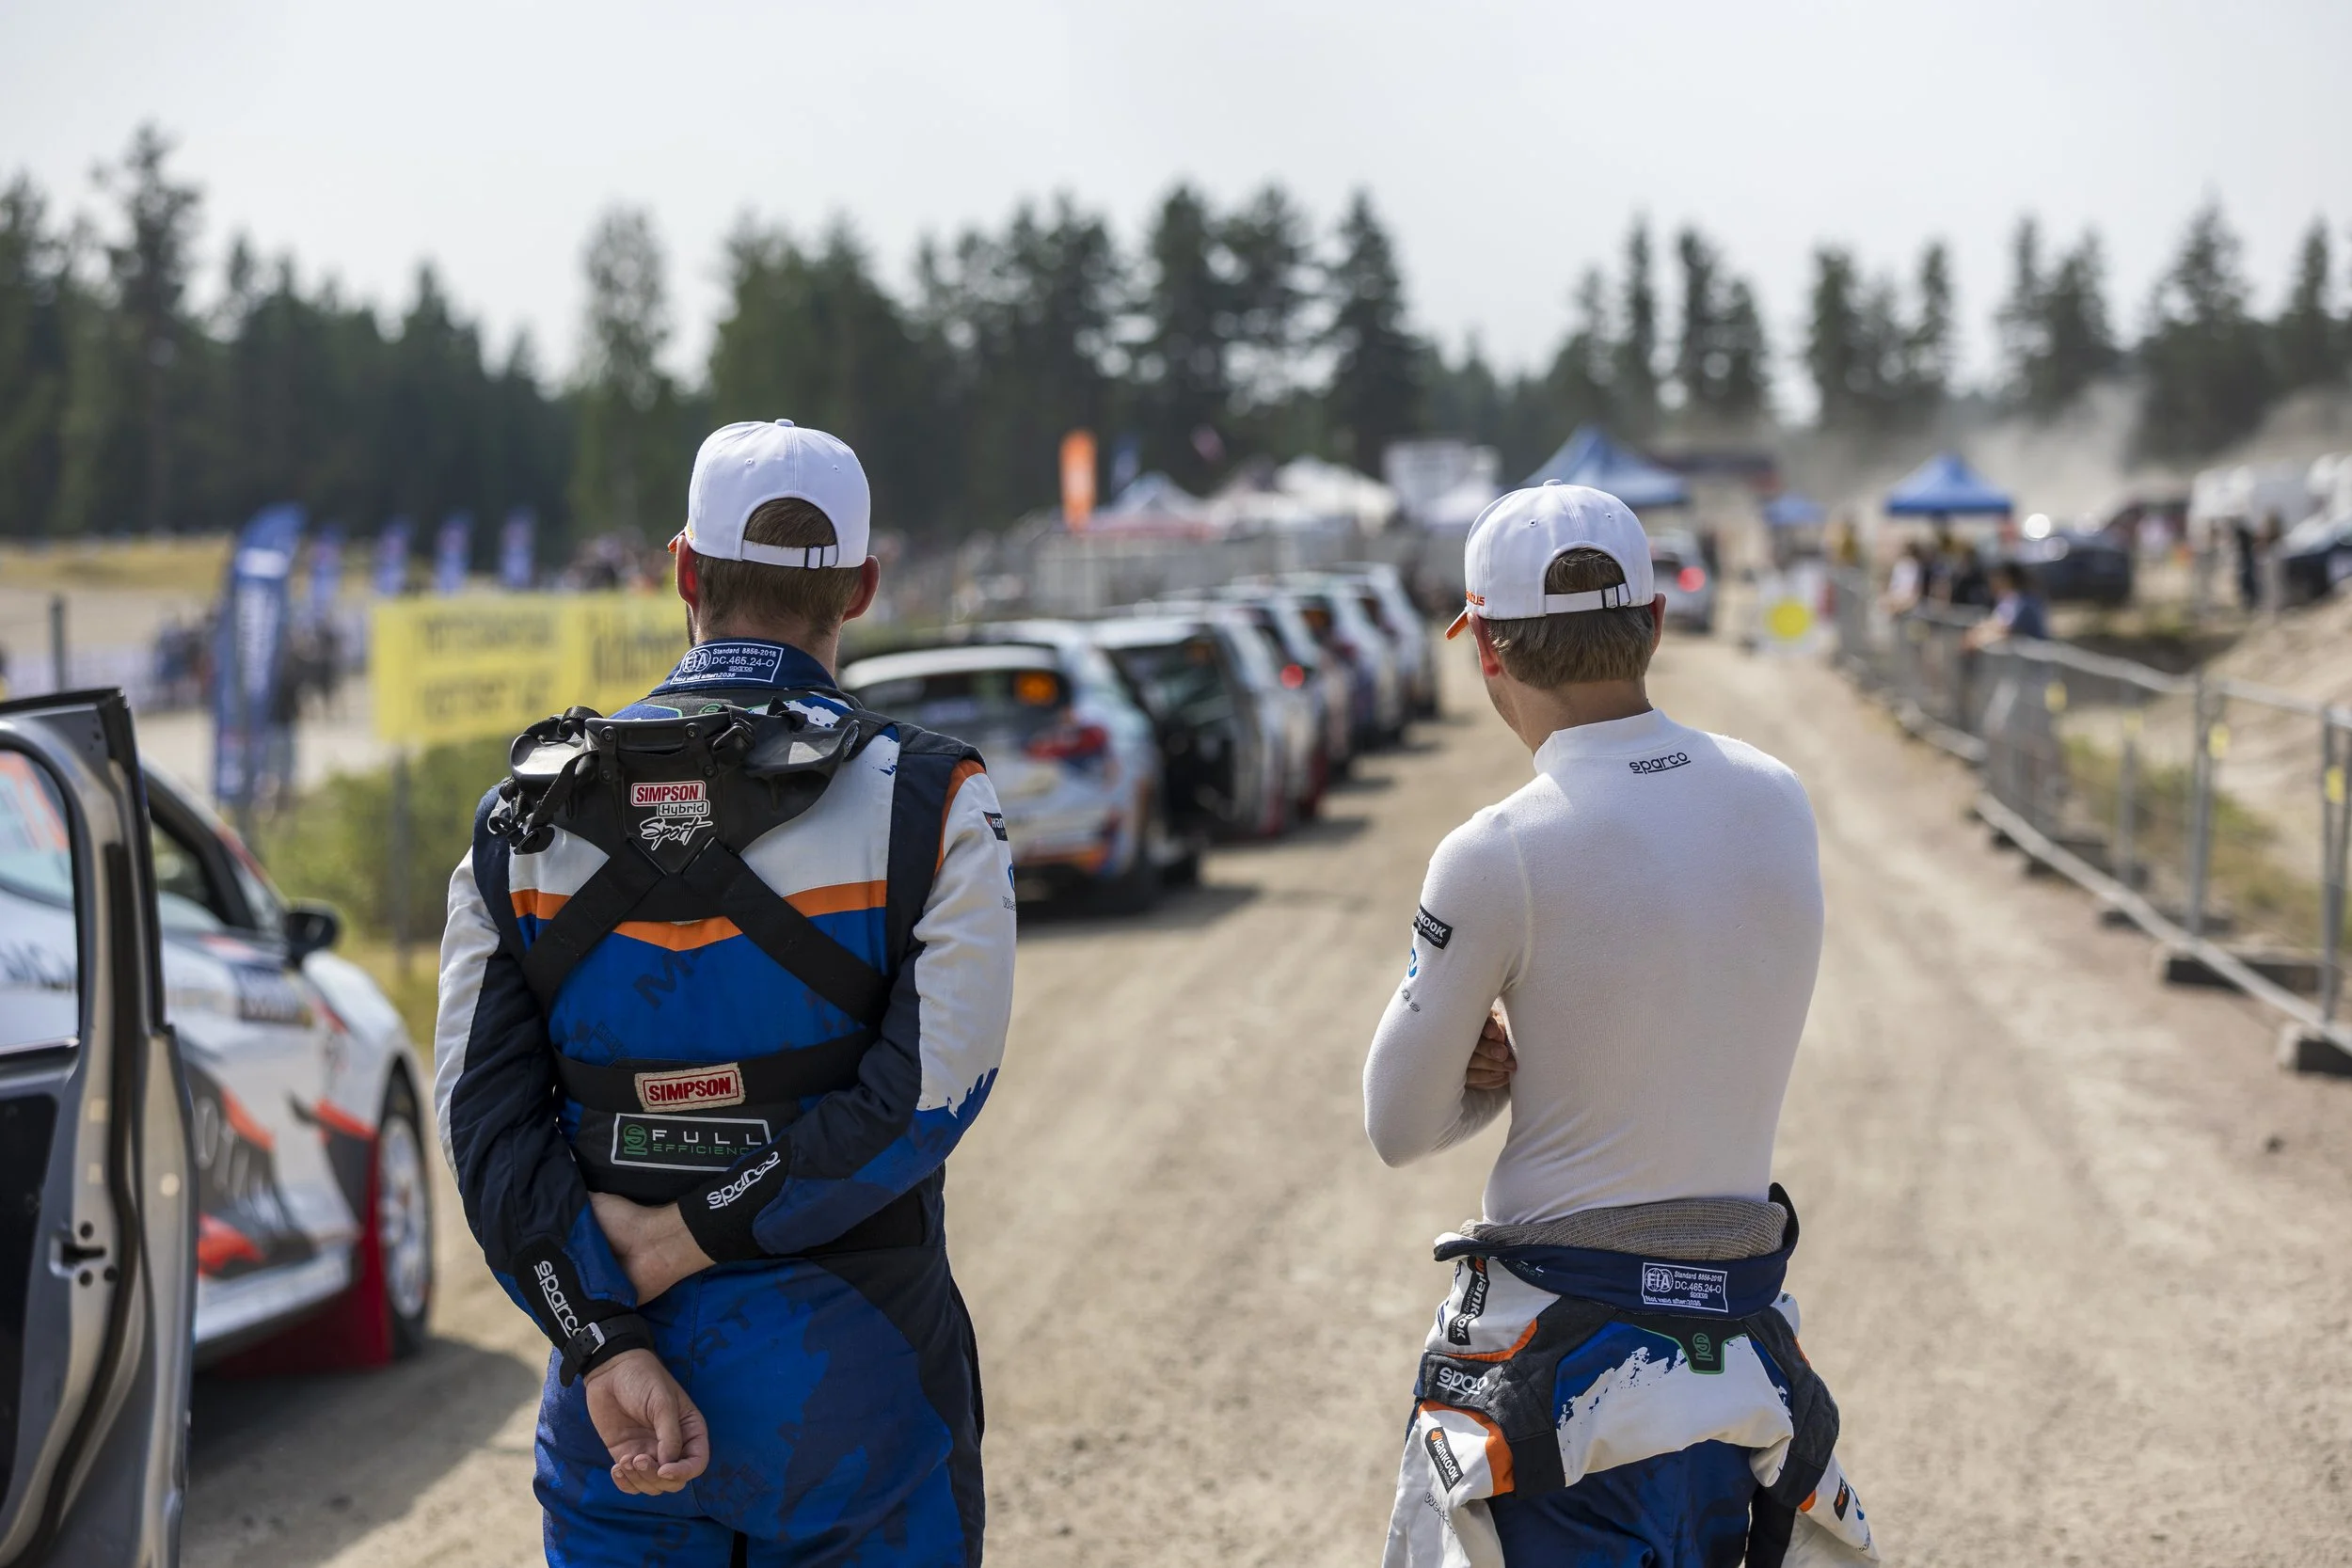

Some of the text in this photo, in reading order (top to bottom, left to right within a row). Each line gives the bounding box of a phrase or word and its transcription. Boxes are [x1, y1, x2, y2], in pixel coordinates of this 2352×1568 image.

[684, 651, 708, 672] FIA
[741, 648, 777, 657] 8856-2018
[1629, 752, 1692, 775] sparco
[636, 784, 700, 802] SIMPSON
[661, 802, 705, 816] Hybrid
[640, 815, 714, 851] Sport
[648, 1076, 732, 1102] SIMPSON
[652, 1129, 762, 1146] FULL
[653, 1143, 751, 1156] EFFICIENC
[707, 1150, 781, 1210] sparco
[1646, 1271, 1671, 1290] FIA
[1674, 1271, 1697, 1280] Standard
